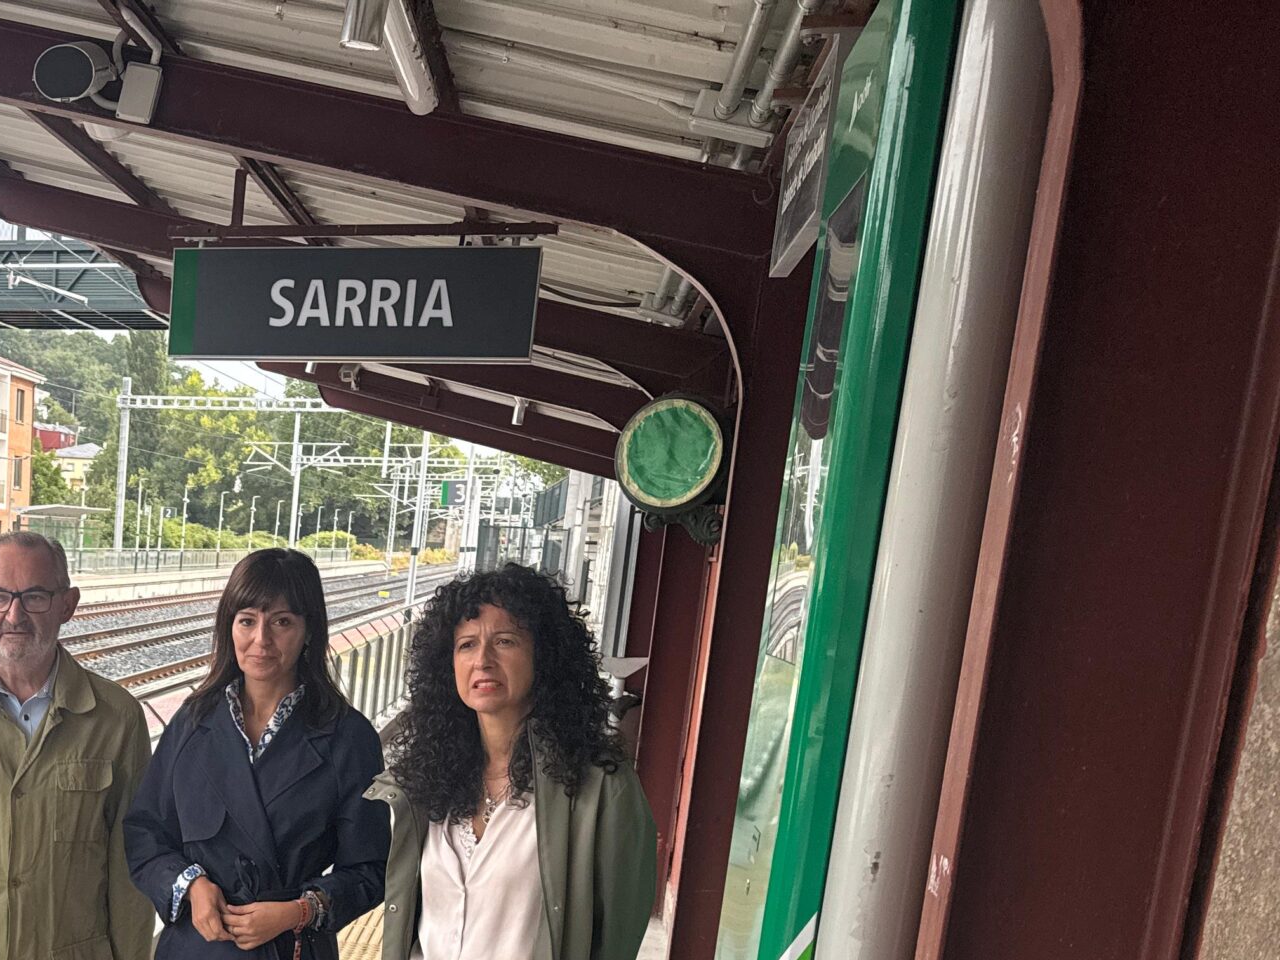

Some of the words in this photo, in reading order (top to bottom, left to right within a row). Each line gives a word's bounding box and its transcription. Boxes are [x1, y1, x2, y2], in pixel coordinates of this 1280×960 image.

[269, 278, 453, 328] SARRIA
[454, 483, 466, 503] 3
[165, 508, 173, 518] 2
